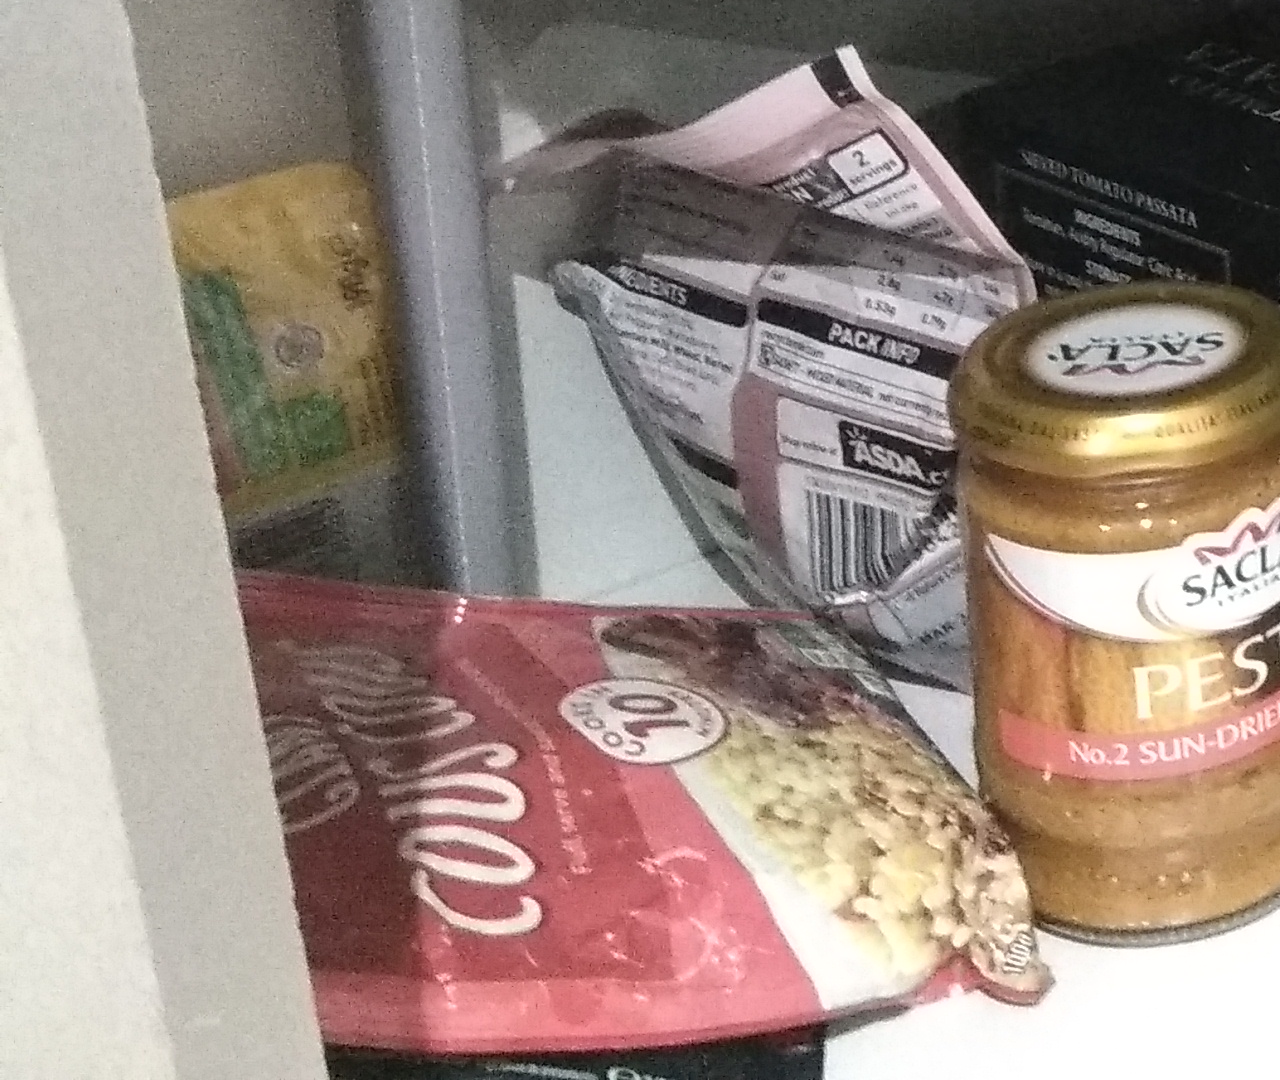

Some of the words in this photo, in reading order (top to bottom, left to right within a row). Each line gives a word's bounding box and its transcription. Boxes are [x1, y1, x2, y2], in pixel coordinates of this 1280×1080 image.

[850, 149, 869, 167] 2
[827, 322, 880, 354] PACK
[879, 335, 922, 366] INFO
[608, 693, 690, 739] 10
[1067, 738, 1131, 767] No.2
